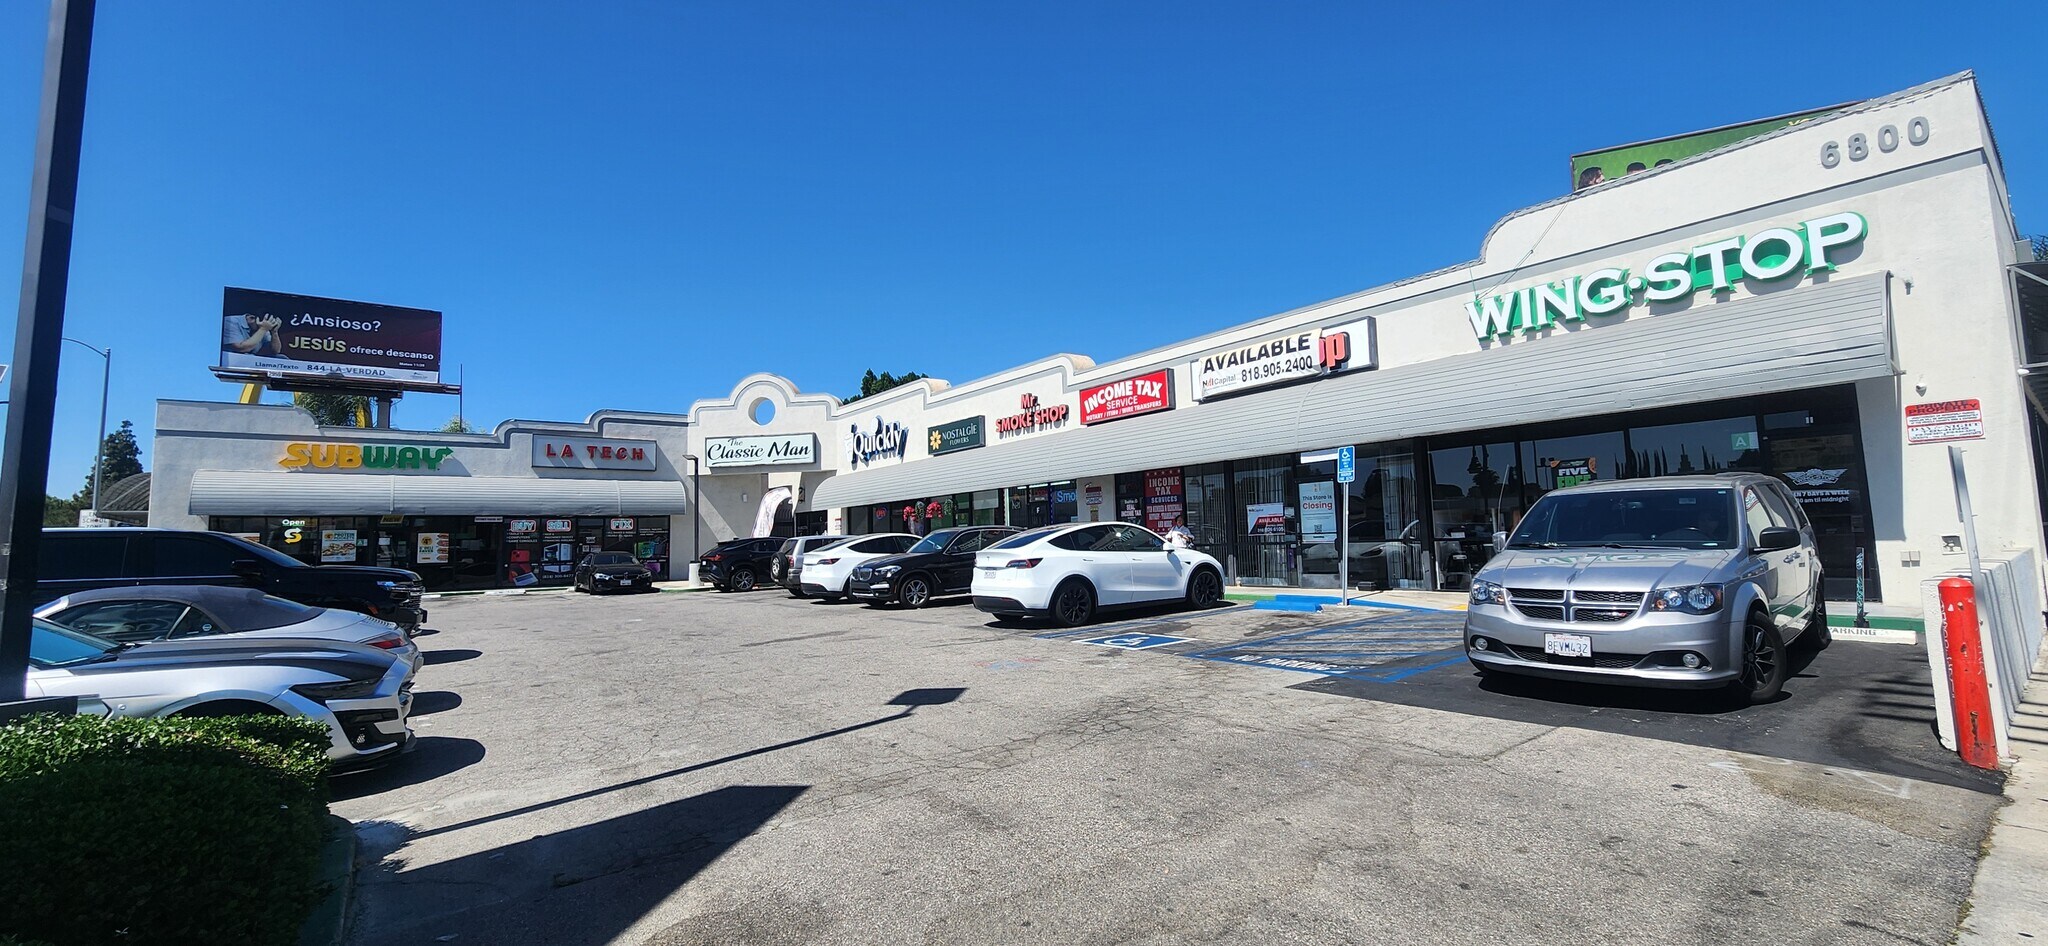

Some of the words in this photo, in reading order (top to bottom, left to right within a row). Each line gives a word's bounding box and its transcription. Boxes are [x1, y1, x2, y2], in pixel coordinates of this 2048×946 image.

[1820, 115, 1930, 169] 6800
[290, 313, 382, 332] ¿Ansioso?
[288, 336, 346, 353] JESÚS
[349, 345, 384, 356] ofrece
[386, 349, 435, 360] descanso
[1203, 333, 1312, 374] AVAILABLE
[1241, 355, 1313, 383] 818.905.2400
[1214, 374, 1237, 385] Capital
[1084, 380, 1134, 414] INCOME
[1135, 380, 1163, 398] TAX
[1106, 396, 1138, 410] SERVICE
[1134, 400, 1162, 412] TRANSFERS
[996, 413, 1032, 433] SMOKE
[1034, 404, 1068, 425] SHOP
[727, 438, 743, 447] The
[1736, 436, 1747, 447] A
[546, 443, 574, 458] LA
[586, 445, 644, 461] TECH
[767, 440, 811, 458] Man
[278, 443, 454, 470] SUBWAY
[1558, 467, 1589, 476] FIVE
[1149, 476, 1180, 488] INCOME
[1155, 486, 1171, 496] TAX
[1151, 495, 1178, 504] SERVICES
[1302, 501, 1333, 511] Closing
[282, 519, 306, 527] Open
[511, 520, 535, 532] BUY
[547, 520, 570, 531] SELL
[612, 520, 632, 529] FIX
[1829, 626, 1877, 636] ARKING
[1547, 640, 1588, 654] 8EVM432
